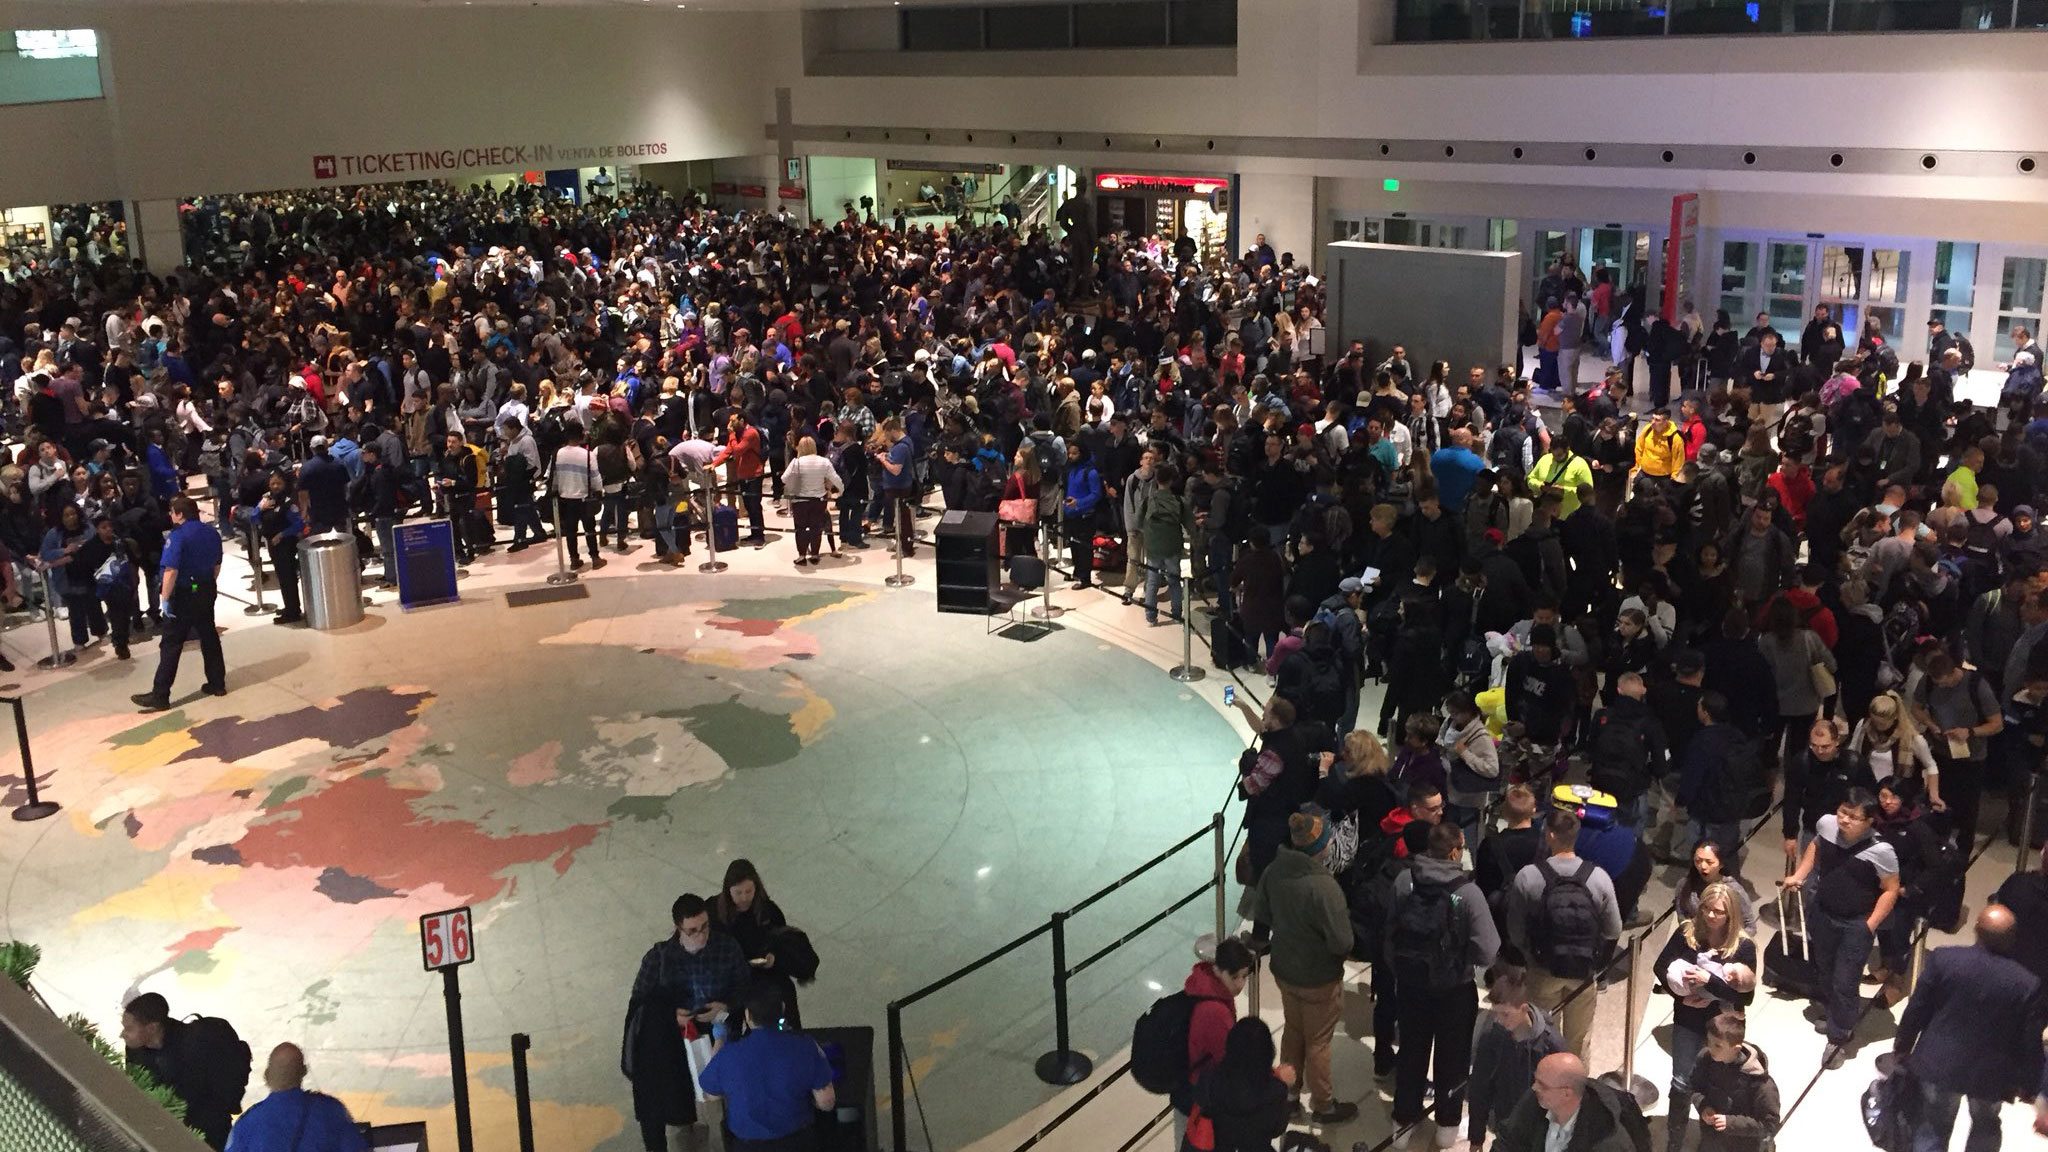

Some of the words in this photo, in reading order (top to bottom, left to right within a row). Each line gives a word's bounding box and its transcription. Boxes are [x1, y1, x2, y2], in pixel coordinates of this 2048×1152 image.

[341, 145, 552, 175] TICKETING/CHECK-IN
[558, 148, 596, 160] VENTA
[600, 146, 615, 158] DE
[617, 143, 667, 157] BOLETOS
[426, 918, 443, 966] 5
[452, 913, 468, 960] 6
